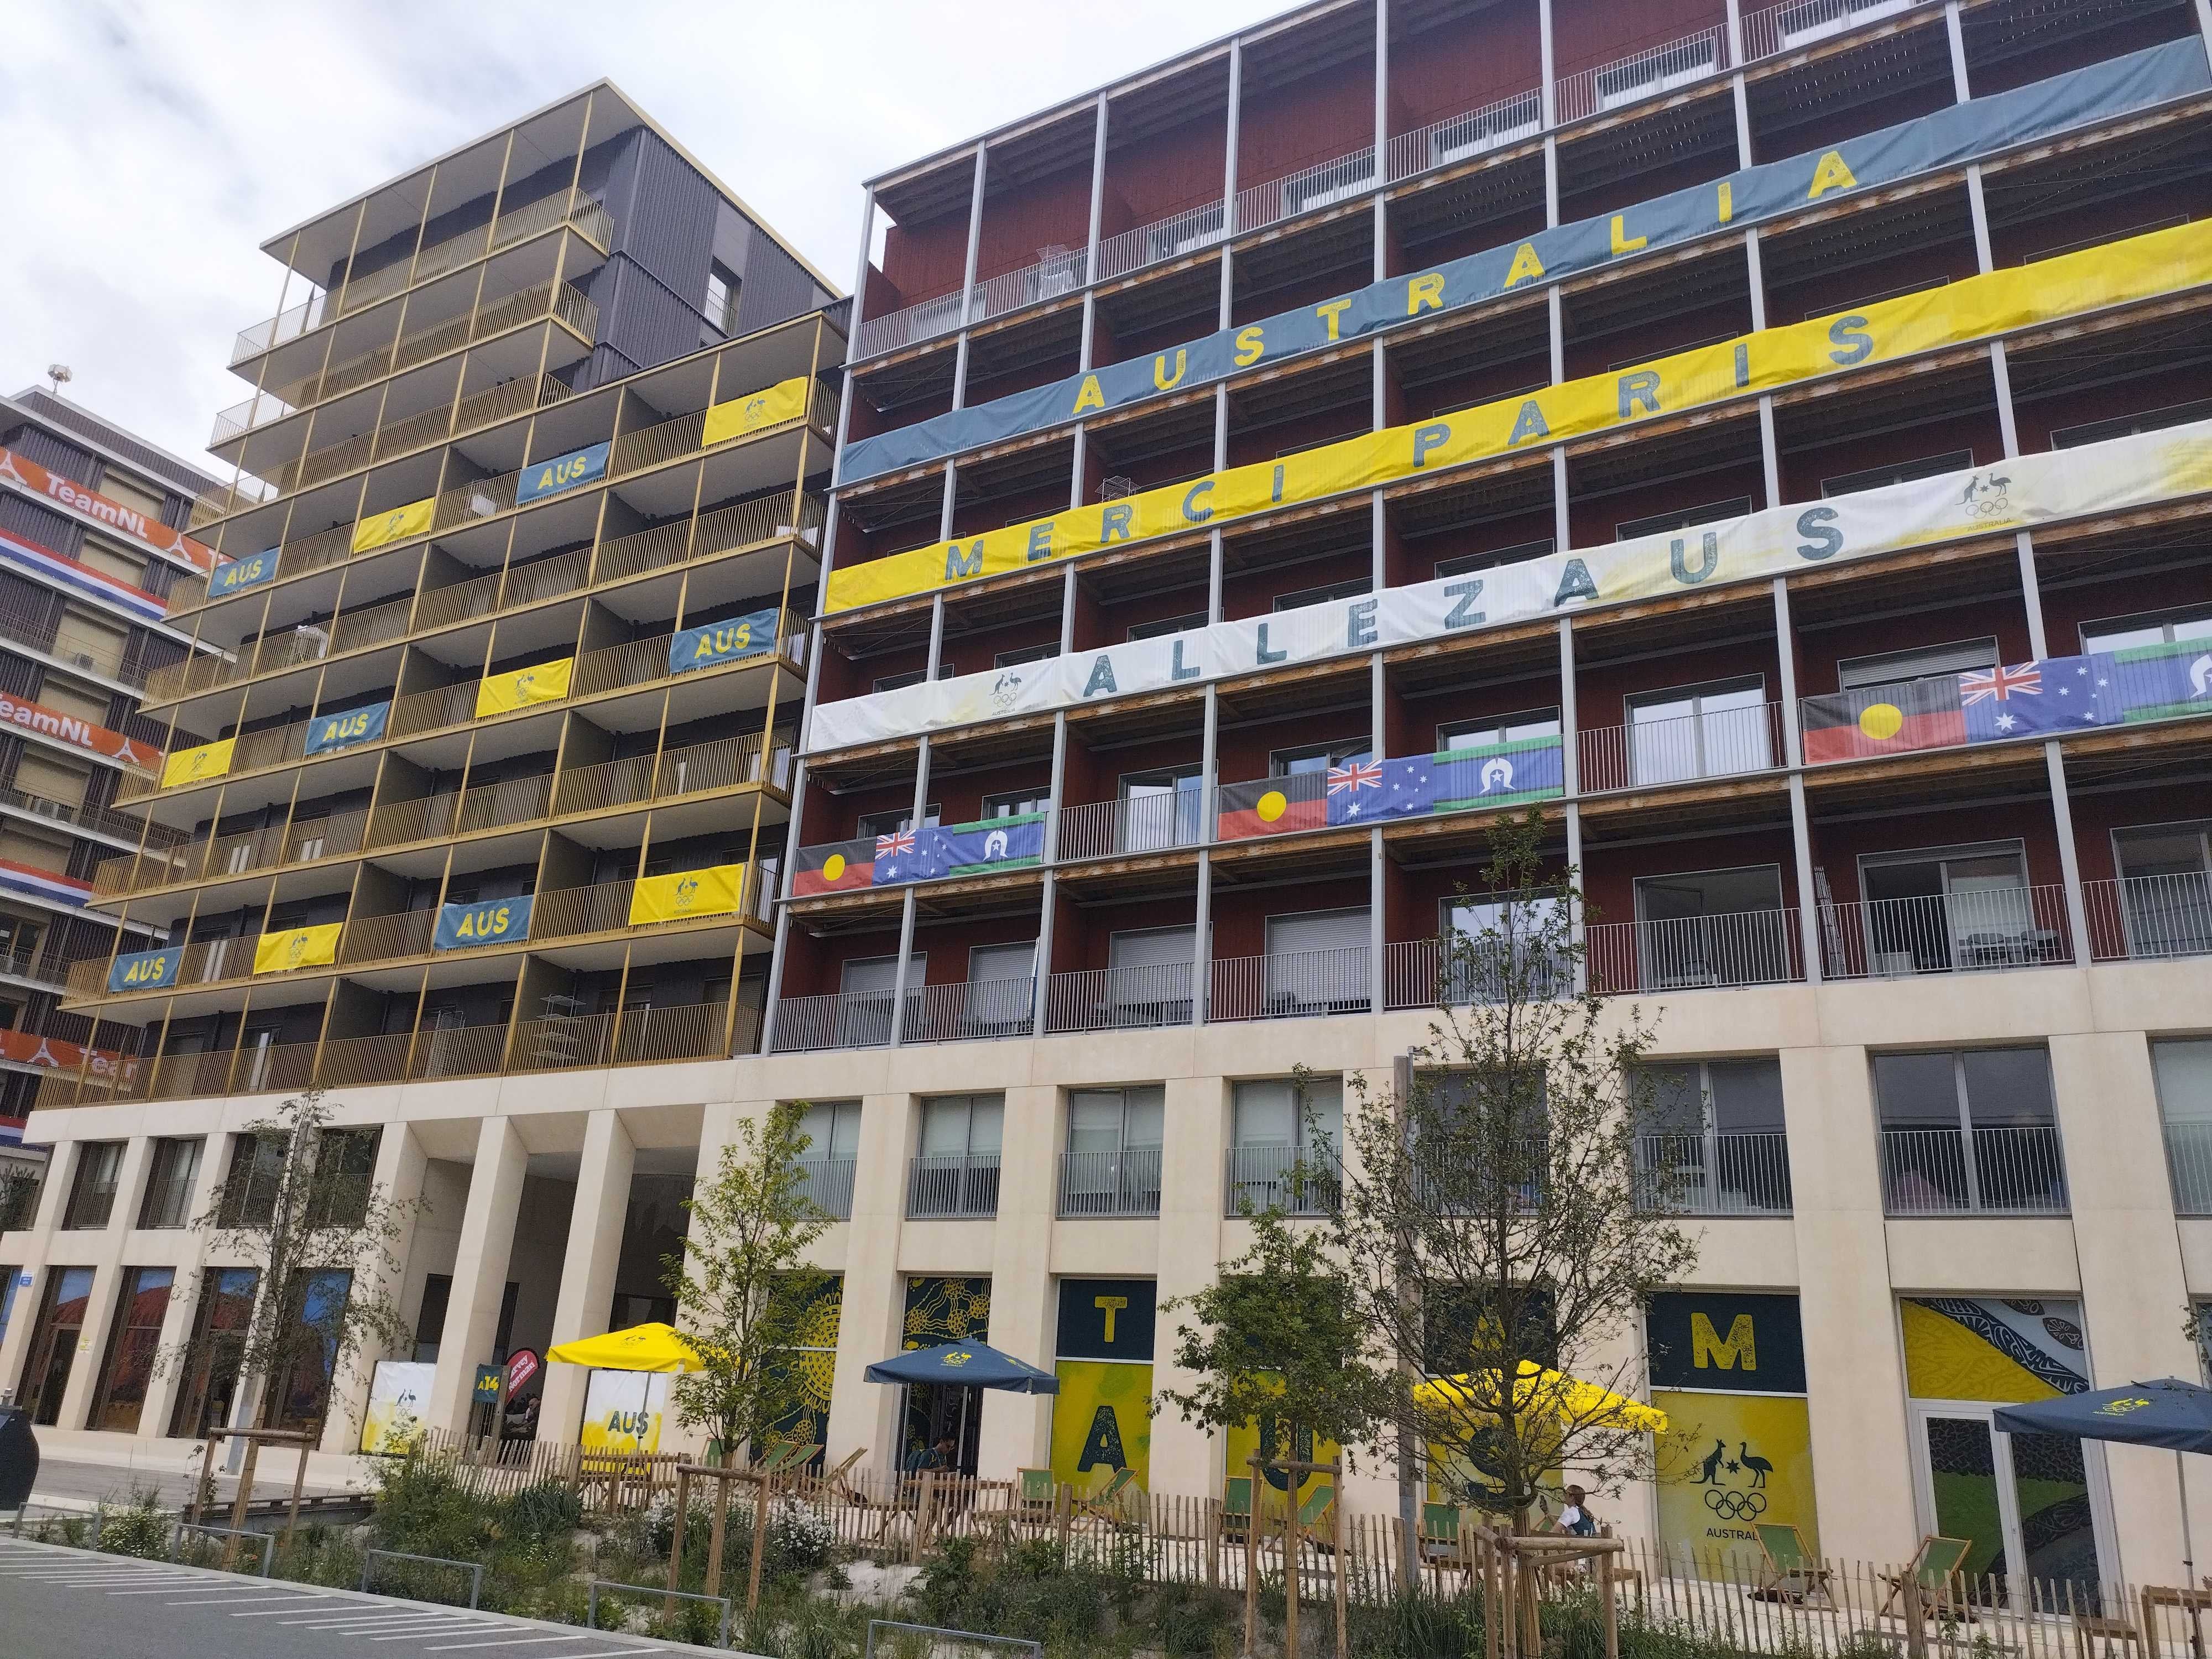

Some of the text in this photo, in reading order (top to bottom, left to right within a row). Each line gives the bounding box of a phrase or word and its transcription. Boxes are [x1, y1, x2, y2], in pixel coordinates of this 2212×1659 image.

[1072, 150, 1858, 414] AUSTRALIA
[945, 316, 1873, 581] MERCI PARIS
[538, 456, 587, 490] AUS
[46, 472, 148, 539] TeamNL
[1968, 517, 2012, 531] AUSTRALIA
[223, 560, 263, 587] AUS
[1083, 507, 1844, 697] ALLEZ AUS
[695, 623, 751, 659] AUS
[0, 693, 93, 746] eamNL
[322, 713, 369, 742] AUS
[992, 707, 1016, 717] AUSTRALIA
[456, 907, 509, 938] AUS
[123, 957, 165, 982] AUS
[607, 1411, 649, 1434] AUS
[1706, 1527, 1759, 1541] AUSTRAL
